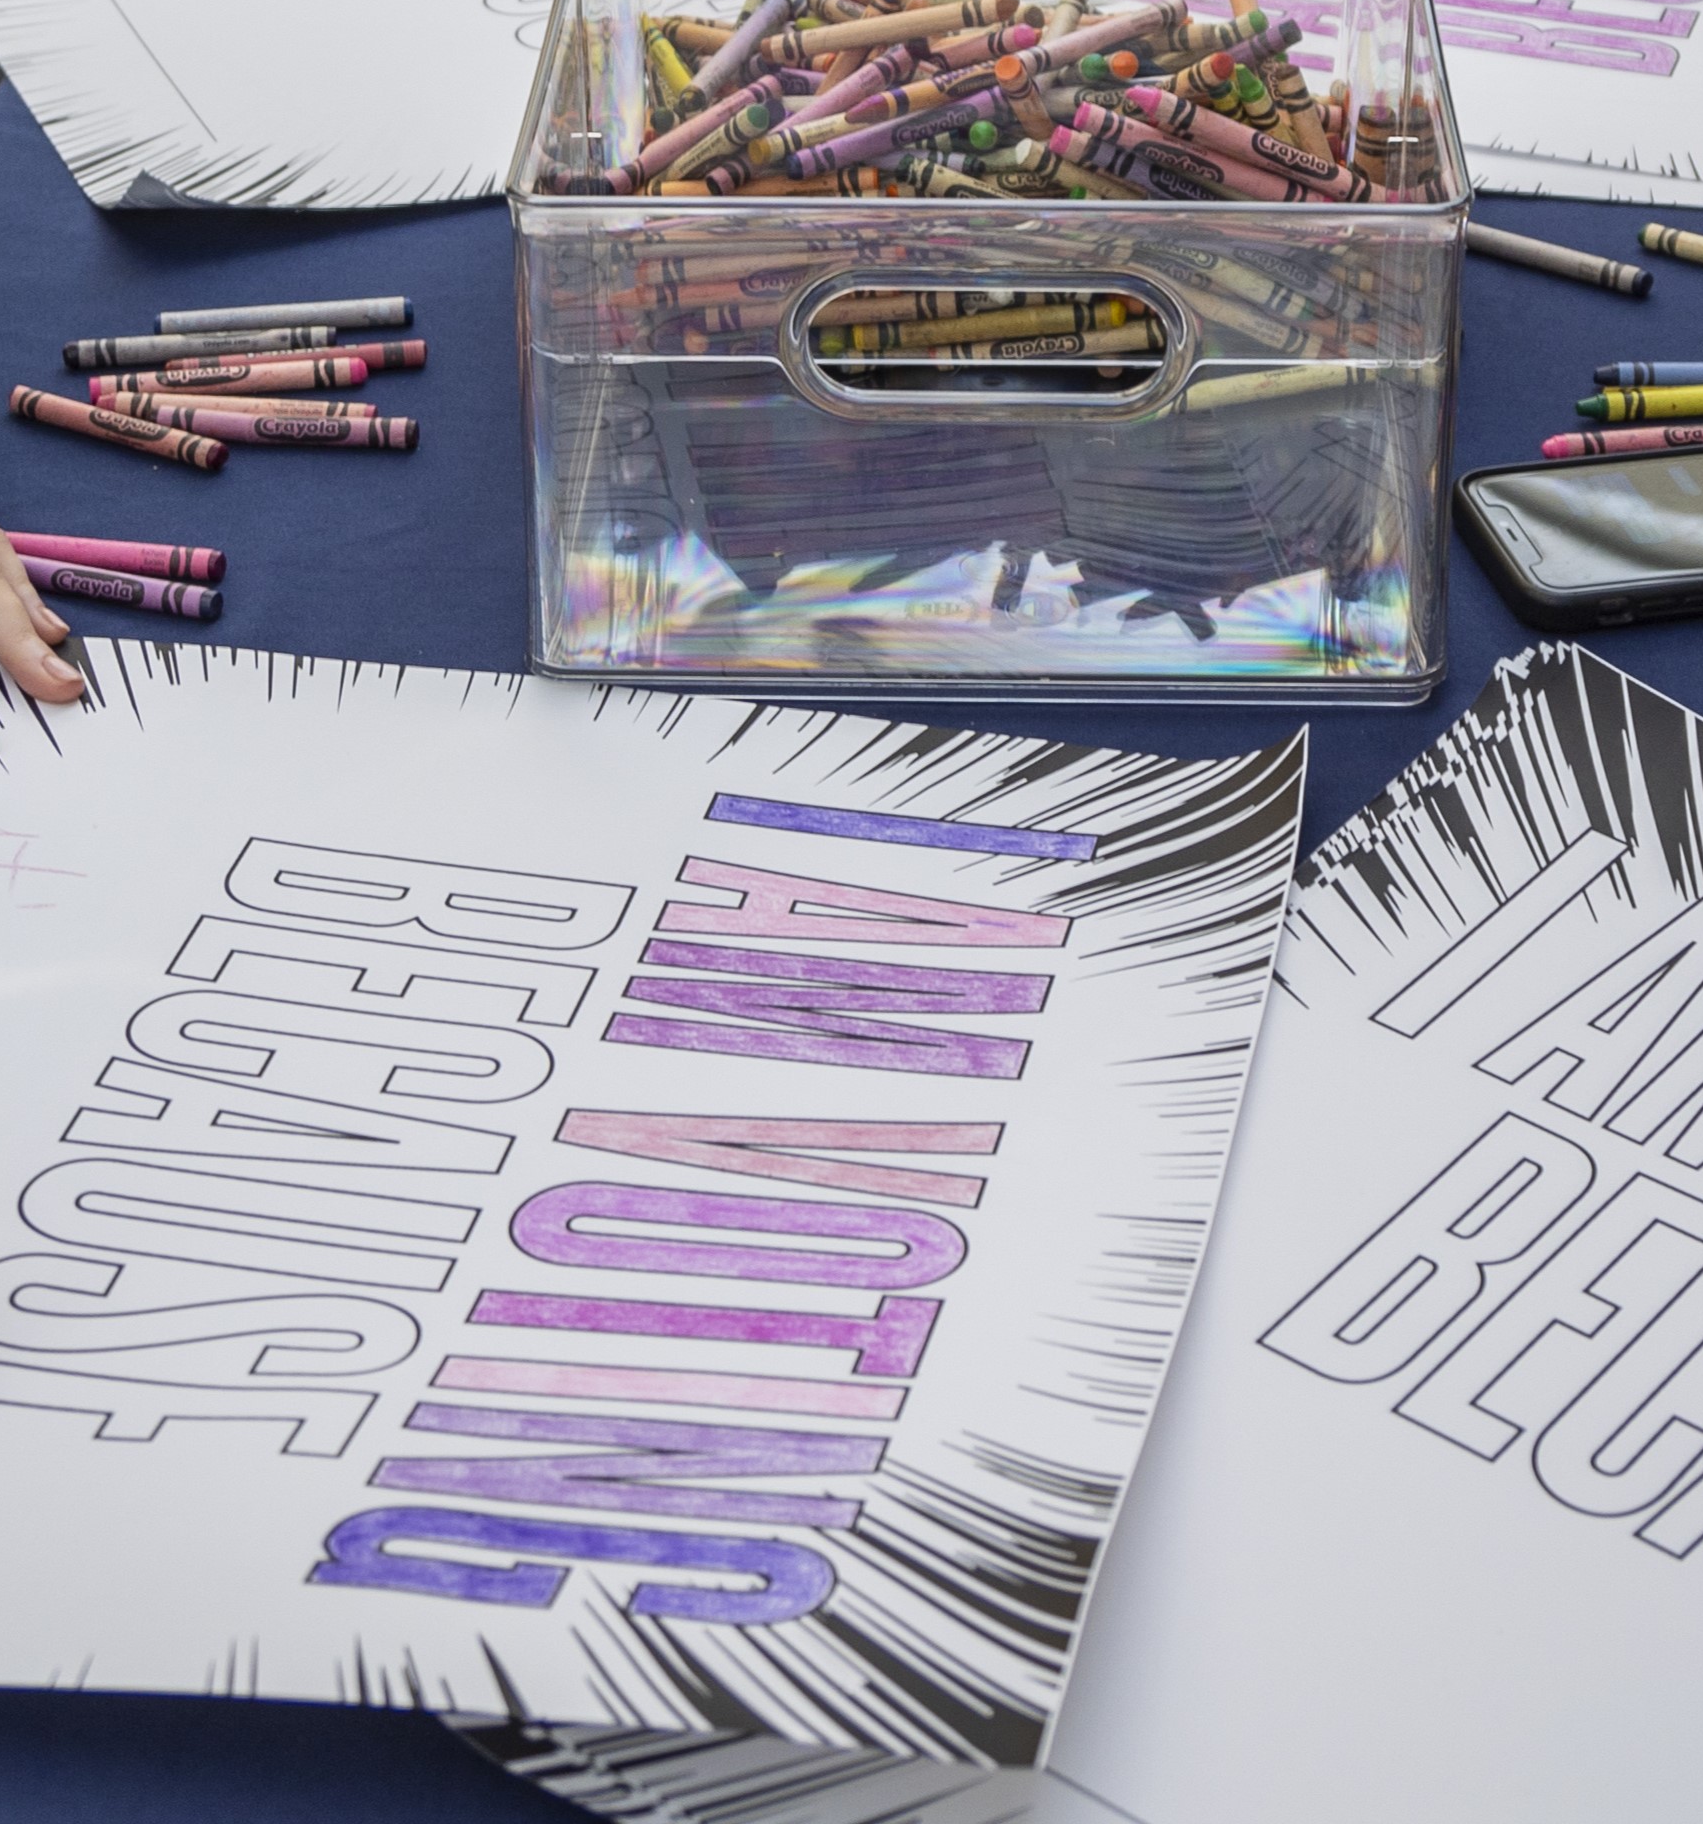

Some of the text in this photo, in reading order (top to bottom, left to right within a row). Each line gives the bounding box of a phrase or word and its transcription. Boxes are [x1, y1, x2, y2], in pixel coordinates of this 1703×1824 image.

[898, 111, 969, 142] Crayola
[1147, 146, 1219, 182] Crayola
[1258, 134, 1329, 173] Crayola
[1001, 333, 1082, 359] Crayola
[95, 410, 162, 436] Crayola
[261, 416, 340, 438] Crayola
[56, 570, 134, 601] Crayola
[1369, 826, 1630, 1040] I
[304, 792, 1099, 1627] I AM VOTING
